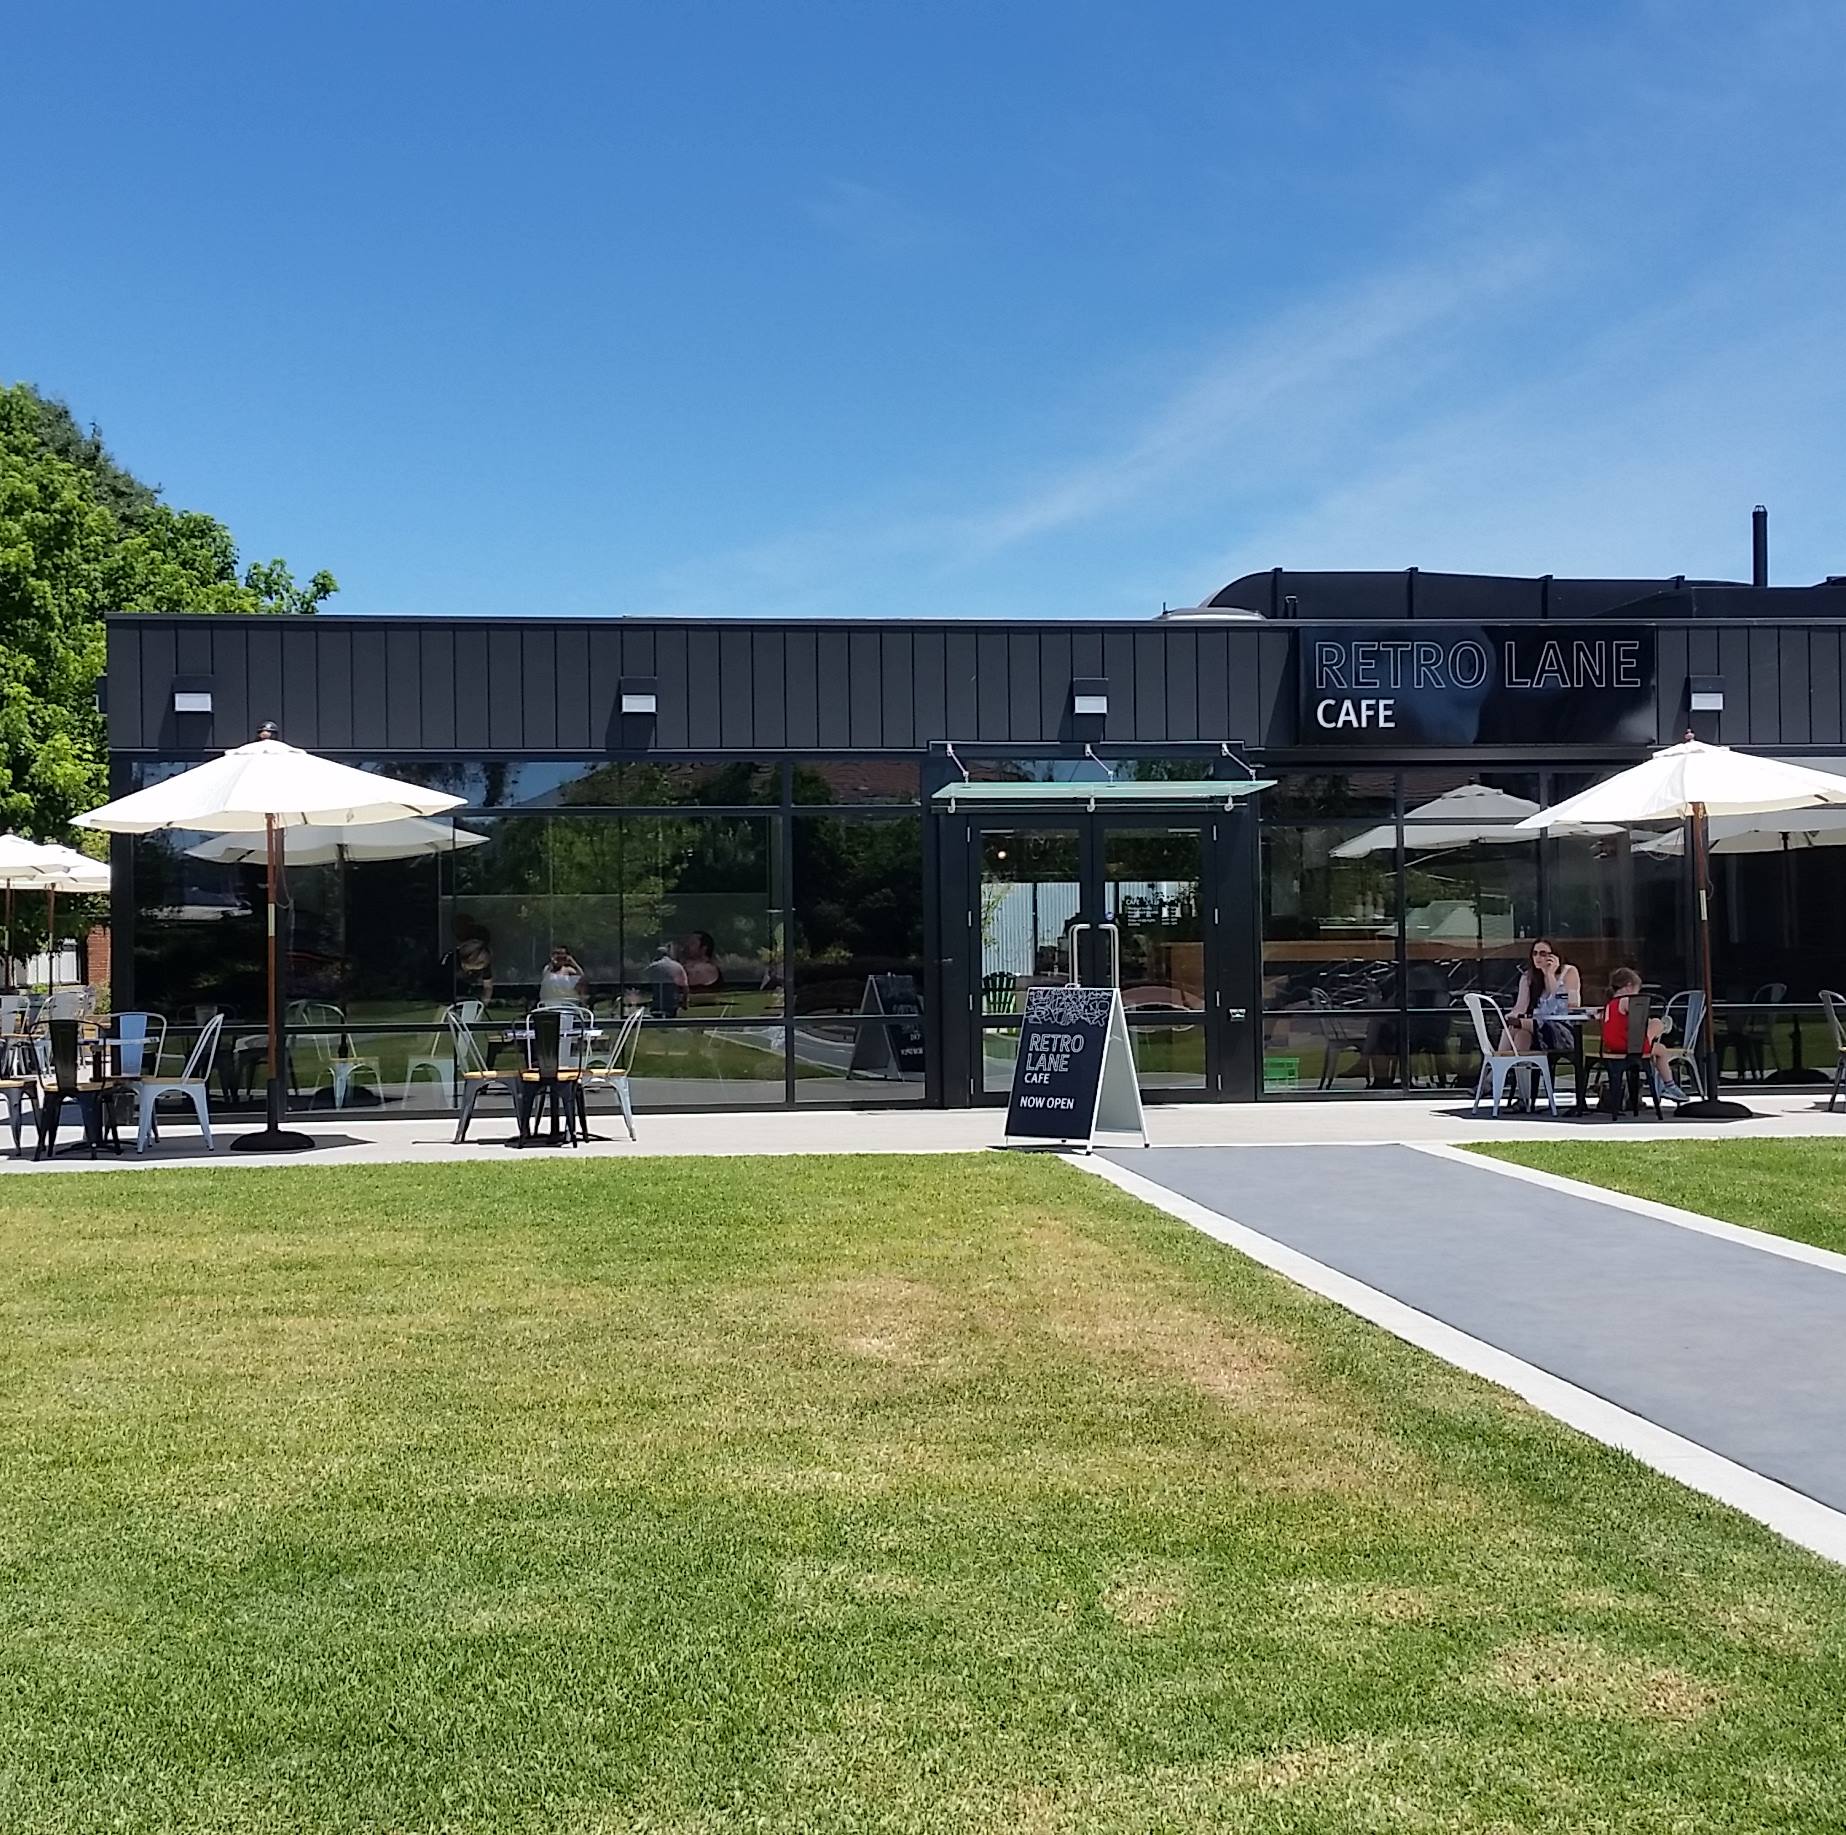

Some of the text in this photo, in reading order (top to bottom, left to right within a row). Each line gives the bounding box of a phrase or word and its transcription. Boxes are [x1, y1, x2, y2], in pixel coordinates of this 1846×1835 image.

[1315, 640, 1641, 689] RETRO LANE
[1316, 699, 1396, 728] CAFE
[1029, 1033, 1085, 1053] RETRO
[1026, 1053, 1070, 1072] LANE
[1024, 1072, 1050, 1084] CAFE
[1020, 1096, 1074, 1109] NOW OPEN
